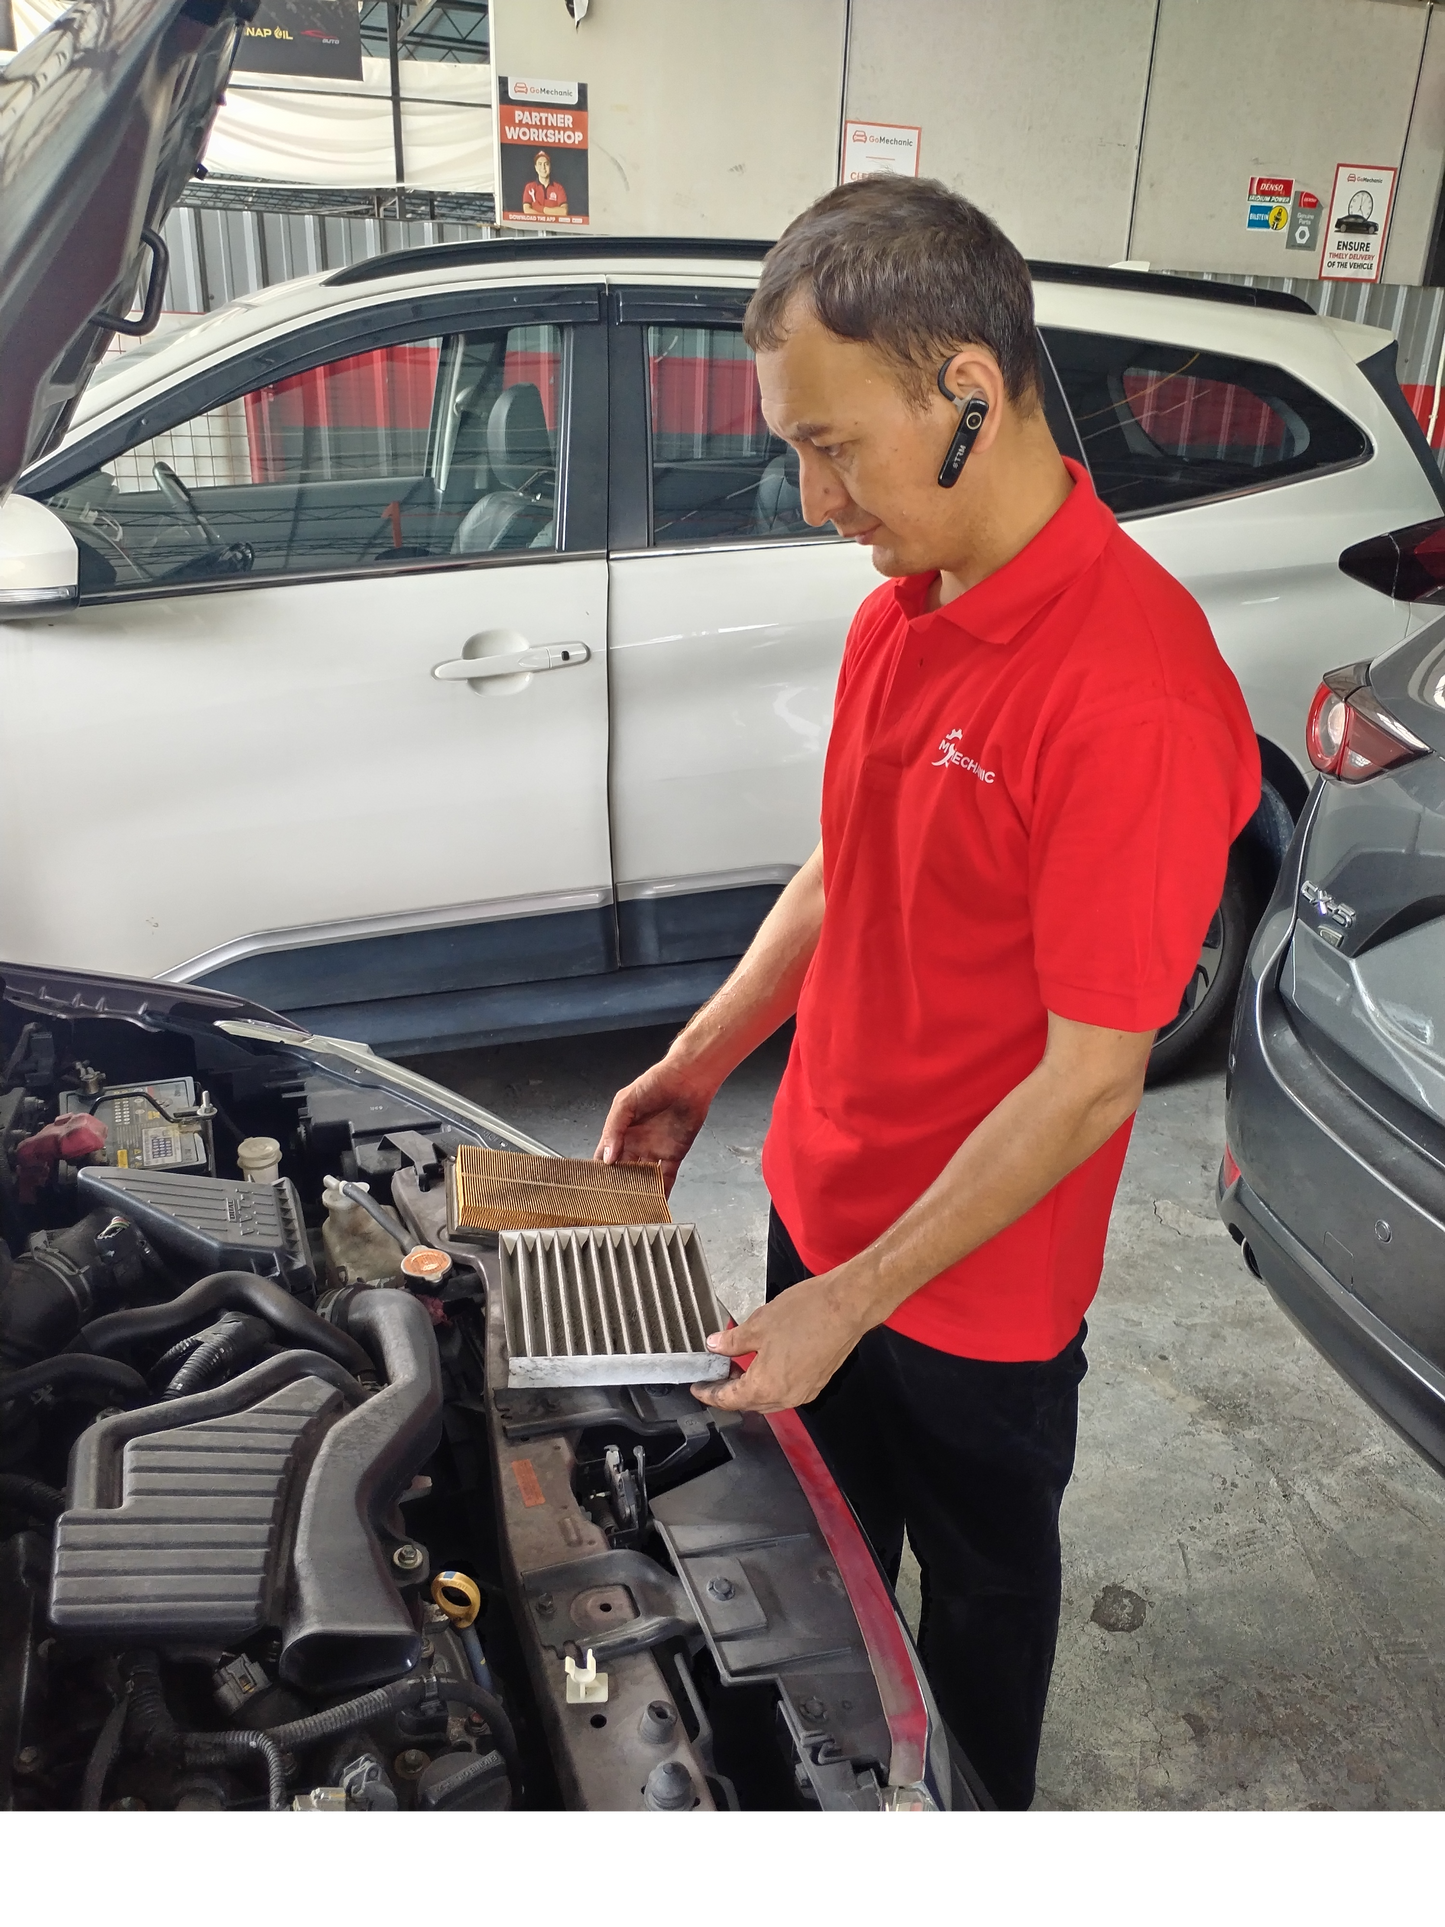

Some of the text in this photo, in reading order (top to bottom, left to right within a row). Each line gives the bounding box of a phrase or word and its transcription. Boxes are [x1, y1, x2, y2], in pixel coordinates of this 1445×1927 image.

[245, 26, 294, 40] NAP OIL
[529, 86, 573, 97] GoMechanic
[514, 110, 573, 128] PARTNER
[505, 126, 583, 144] WORKSHOP
[869, 135, 913, 147] GoMechanic
[1260, 183, 1284, 191] DENSO
[1336, 241, 1371, 252] ENSURE
[1329, 252, 1375, 261] TIMELY DELIVERY
[1336, 261, 1348, 269] THE
[1349, 262, 1374, 270] VEHICLE
[1301, 880, 1356, 928] CX-5
